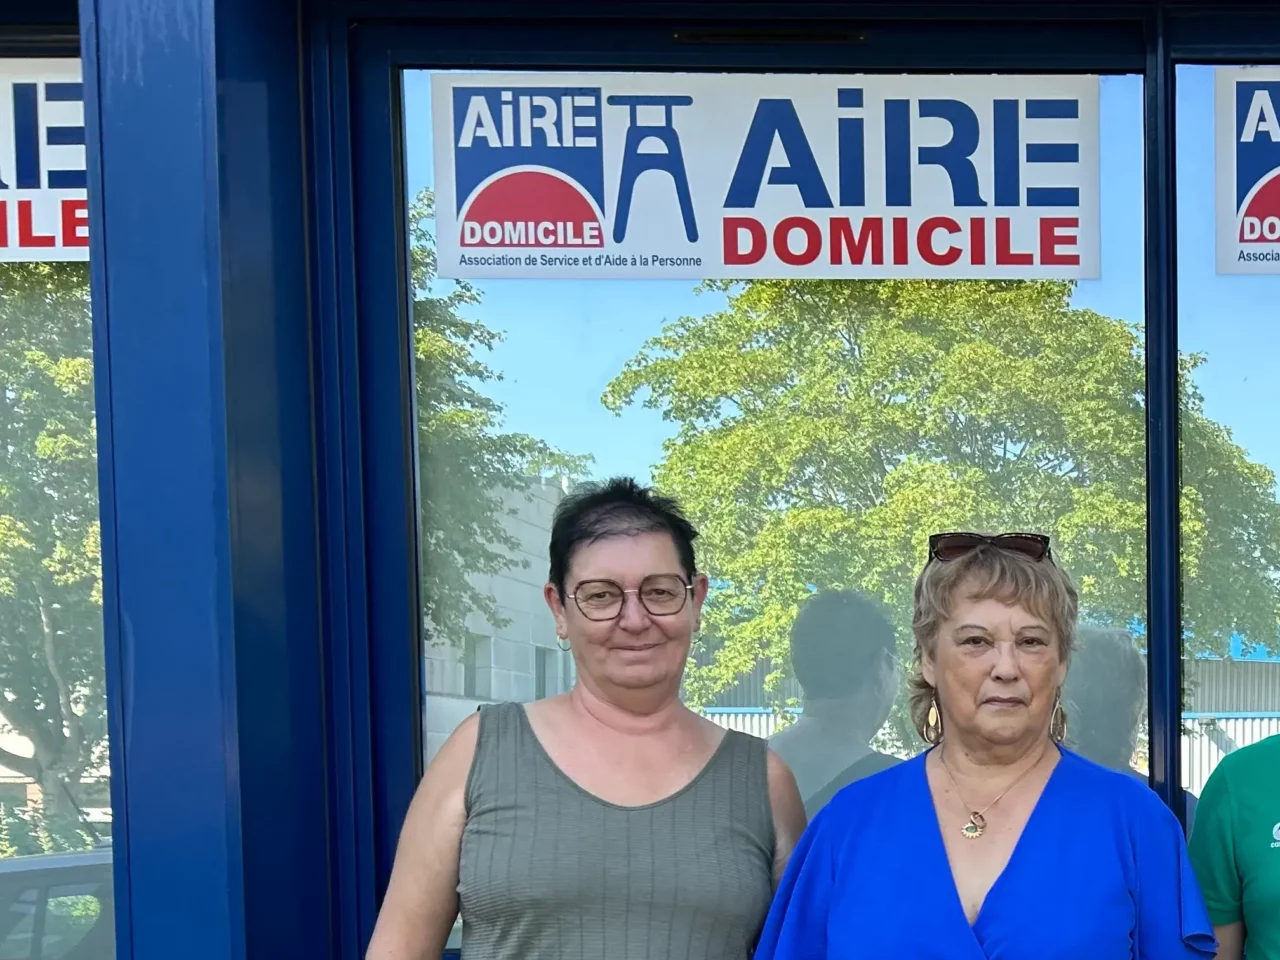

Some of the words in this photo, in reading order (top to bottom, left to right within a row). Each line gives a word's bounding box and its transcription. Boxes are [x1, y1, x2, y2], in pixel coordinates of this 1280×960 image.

[463, 221, 600, 245] DOMICILE
[723, 215, 1081, 267] DOMICILE
[459, 254, 522, 266] Association
[524, 254, 538, 266] de
[540, 254, 580, 266] Service
[582, 255, 592, 266] et
[595, 254, 628, 266] d'Aide
[631, 254, 637, 266] à
[640, 254, 649, 266] la
[651, 254, 702, 266] Personne
